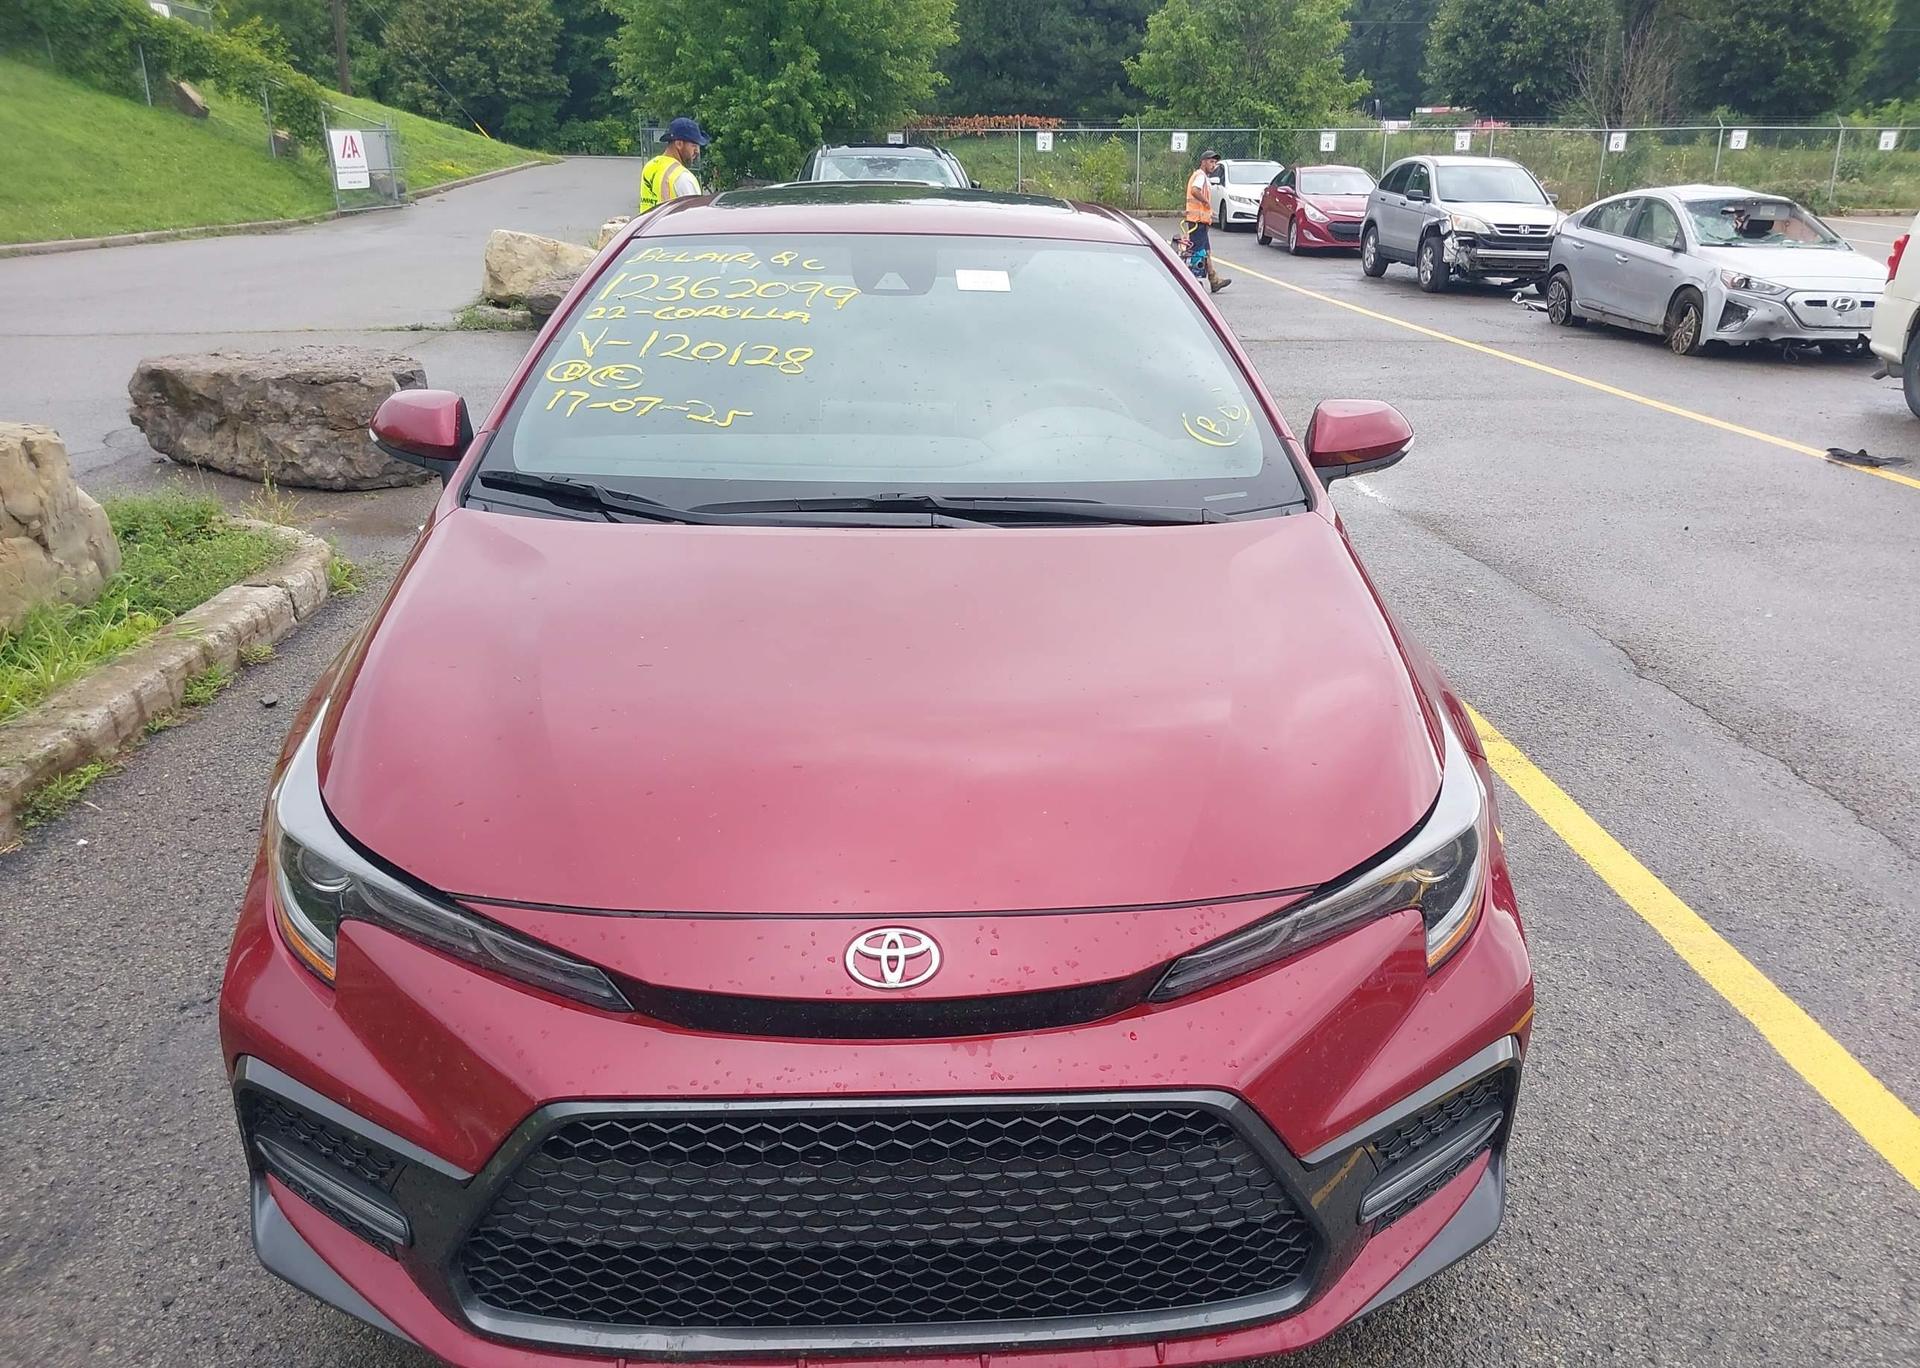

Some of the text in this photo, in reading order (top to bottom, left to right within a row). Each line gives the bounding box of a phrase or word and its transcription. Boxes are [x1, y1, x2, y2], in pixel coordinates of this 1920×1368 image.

[600, 272, 862, 310] 12362099
[577, 327, 814, 374] V-120128
[546, 389, 753, 427] 17-07-25
